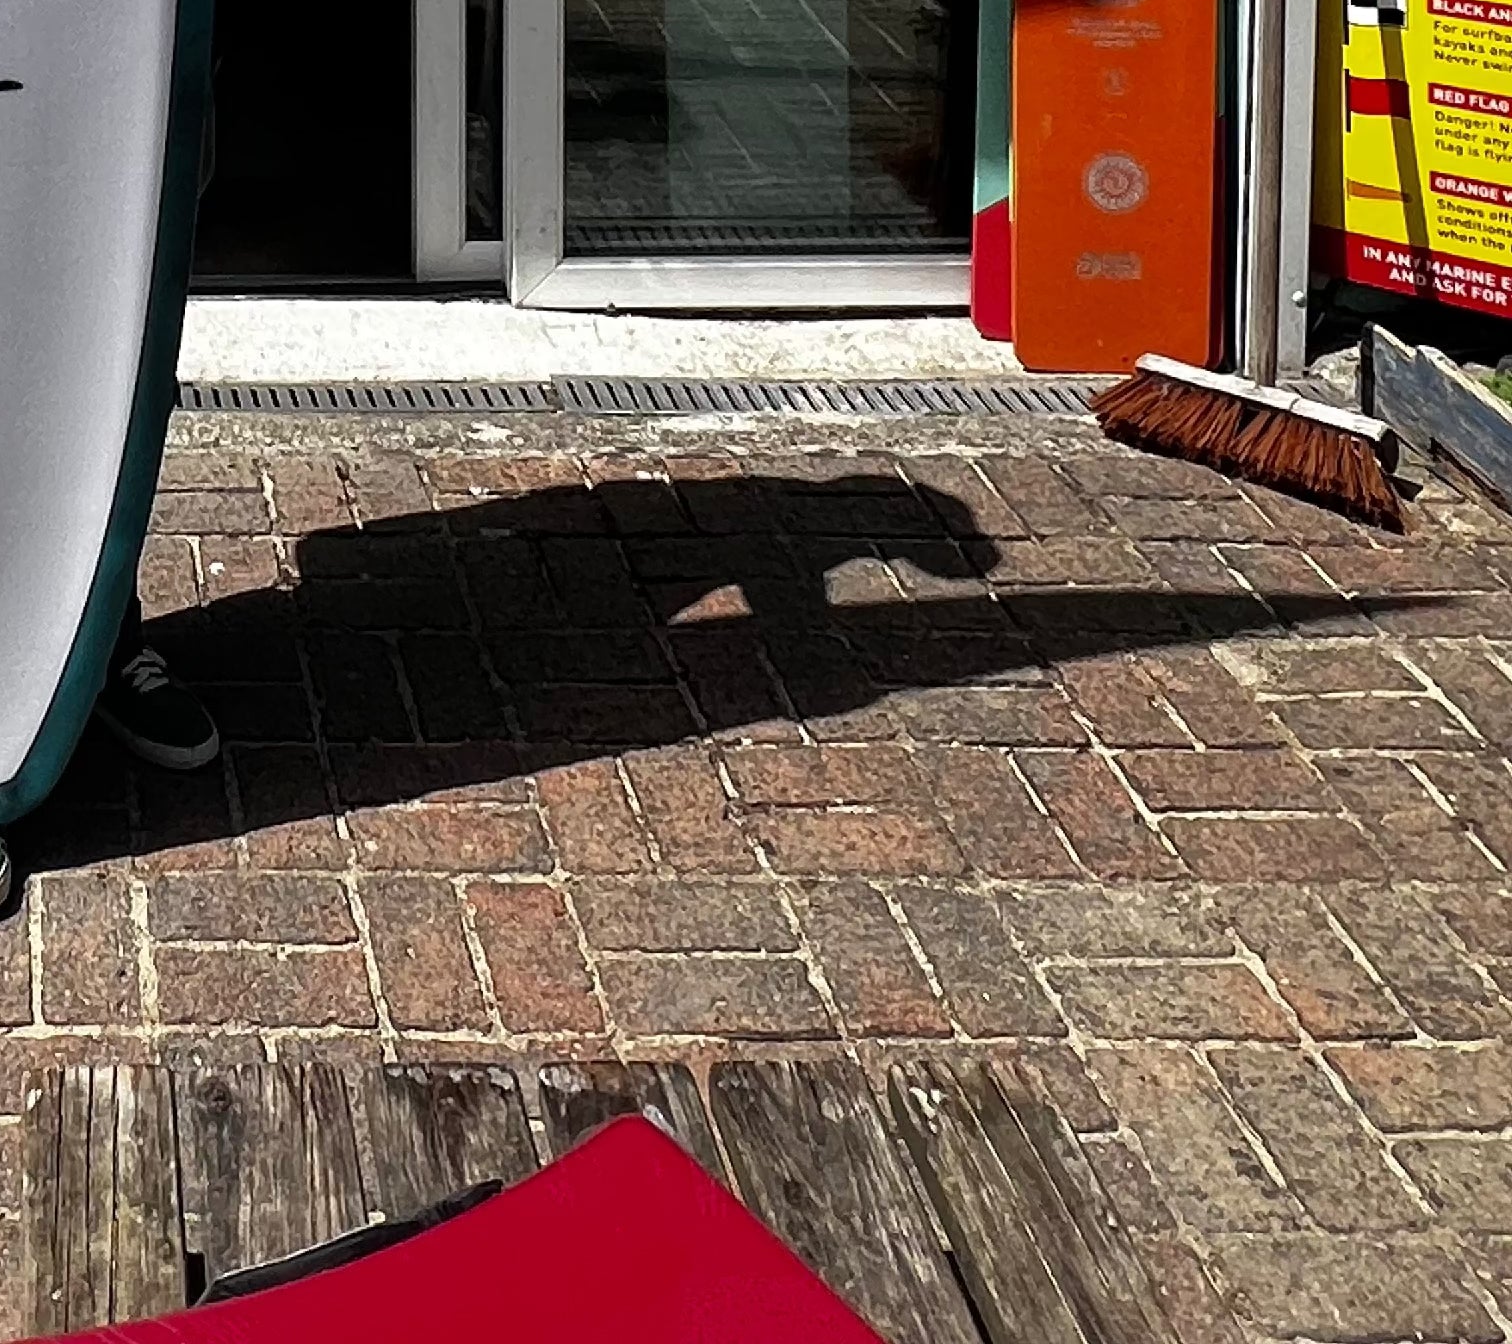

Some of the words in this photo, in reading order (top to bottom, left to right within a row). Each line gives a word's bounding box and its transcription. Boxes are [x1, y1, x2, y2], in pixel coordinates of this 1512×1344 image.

[1434, 20, 1458, 34] For
[1433, 49, 1478, 66] Never
[1433, 88, 1465, 104] RED
[1469, 94, 1509, 114] FLAG
[1434, 126, 1478, 143] under
[1482, 136, 1510, 151] any
[1434, 176, 1499, 202] ORANGE
[1436, 198, 1485, 219] Shows
[1437, 229, 1477, 244] when
[1481, 236, 1506, 251] the
[1362, 244, 1382, 262] IN
[1385, 250, 1422, 269] ANY
[1425, 260, 1497, 288] MARINE
[1389, 267, 1427, 287] AND
[1432, 276, 1468, 298] ASK
[1471, 286, 1508, 307] FOR
